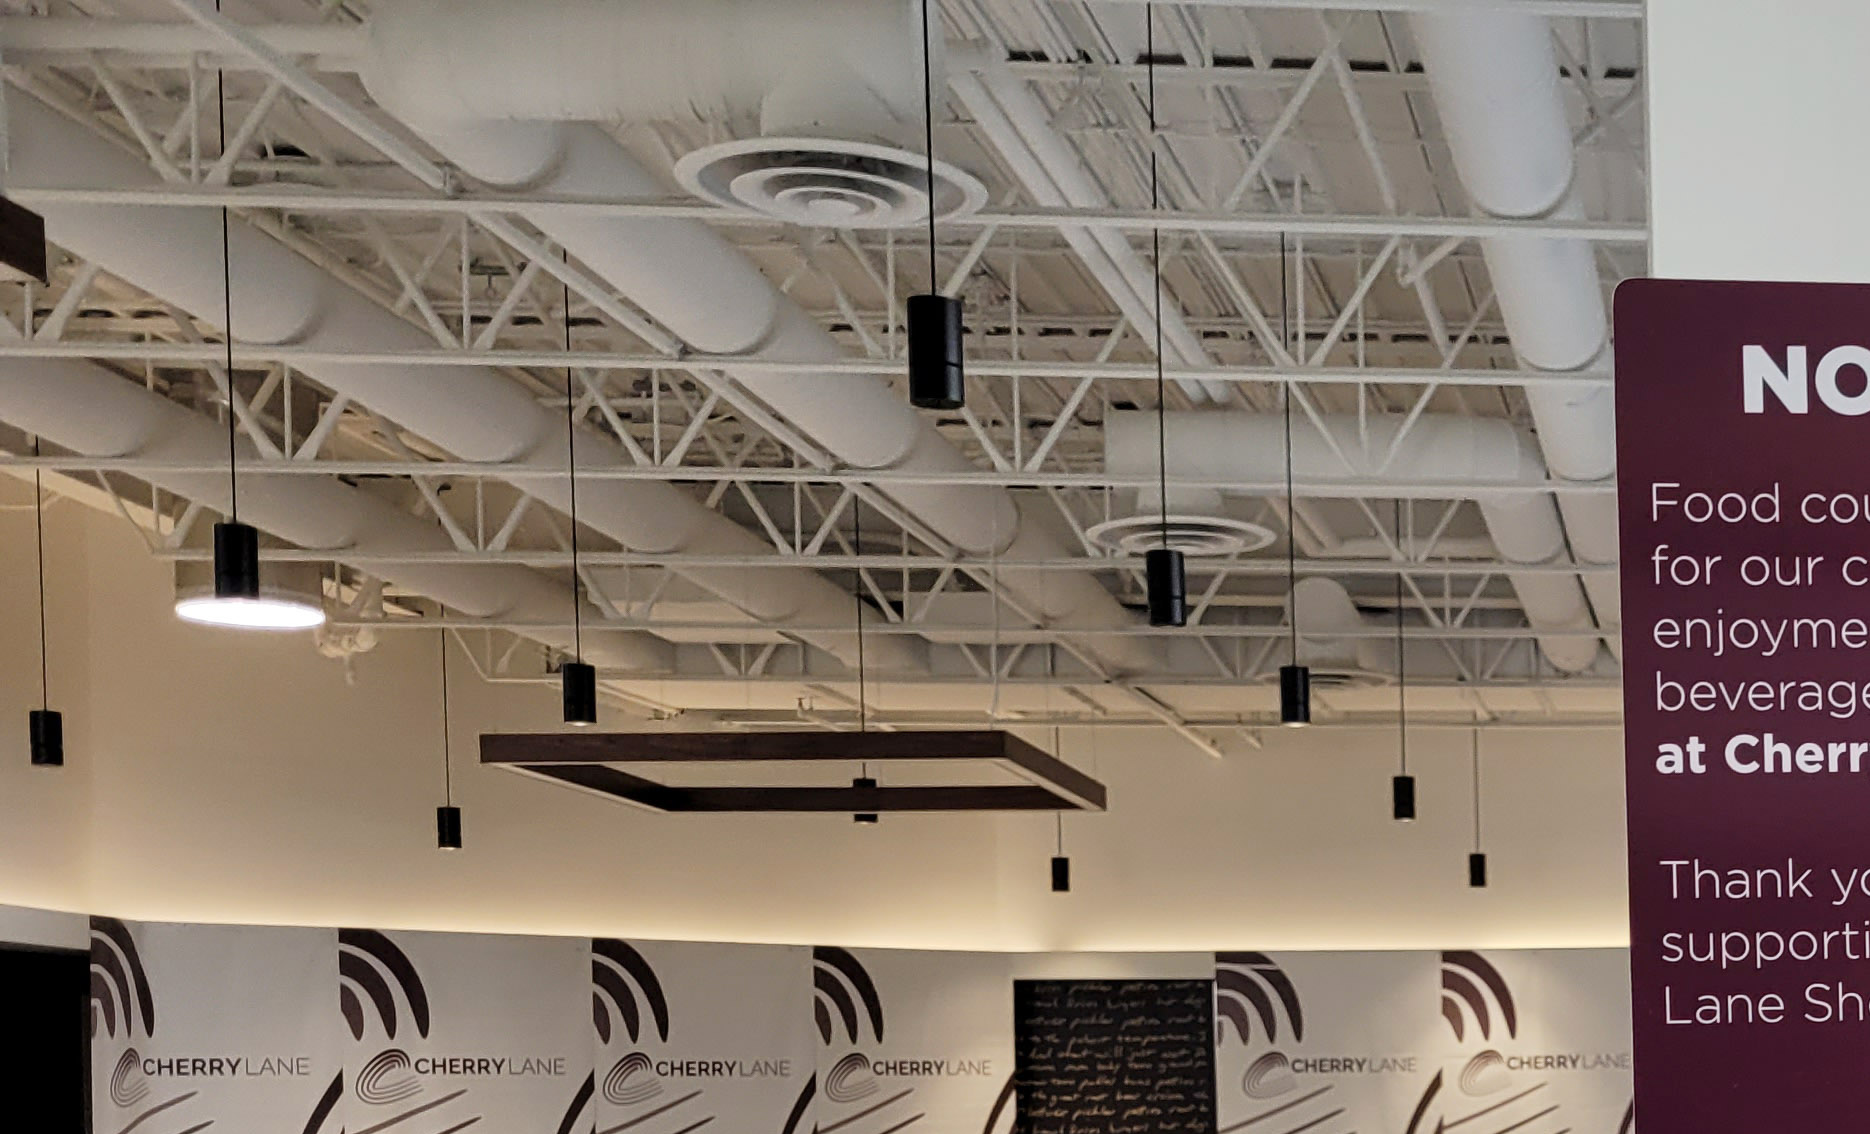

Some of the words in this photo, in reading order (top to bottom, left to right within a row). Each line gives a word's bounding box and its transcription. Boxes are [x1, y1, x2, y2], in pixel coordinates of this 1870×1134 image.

[1651, 482, 1781, 524] Food
[1651, 544, 1722, 586] for
[1740, 555, 1824, 586] our
[1655, 736, 1707, 774] at
[1659, 857, 1814, 899] Thank
[1664, 986, 1786, 1026] Lane
